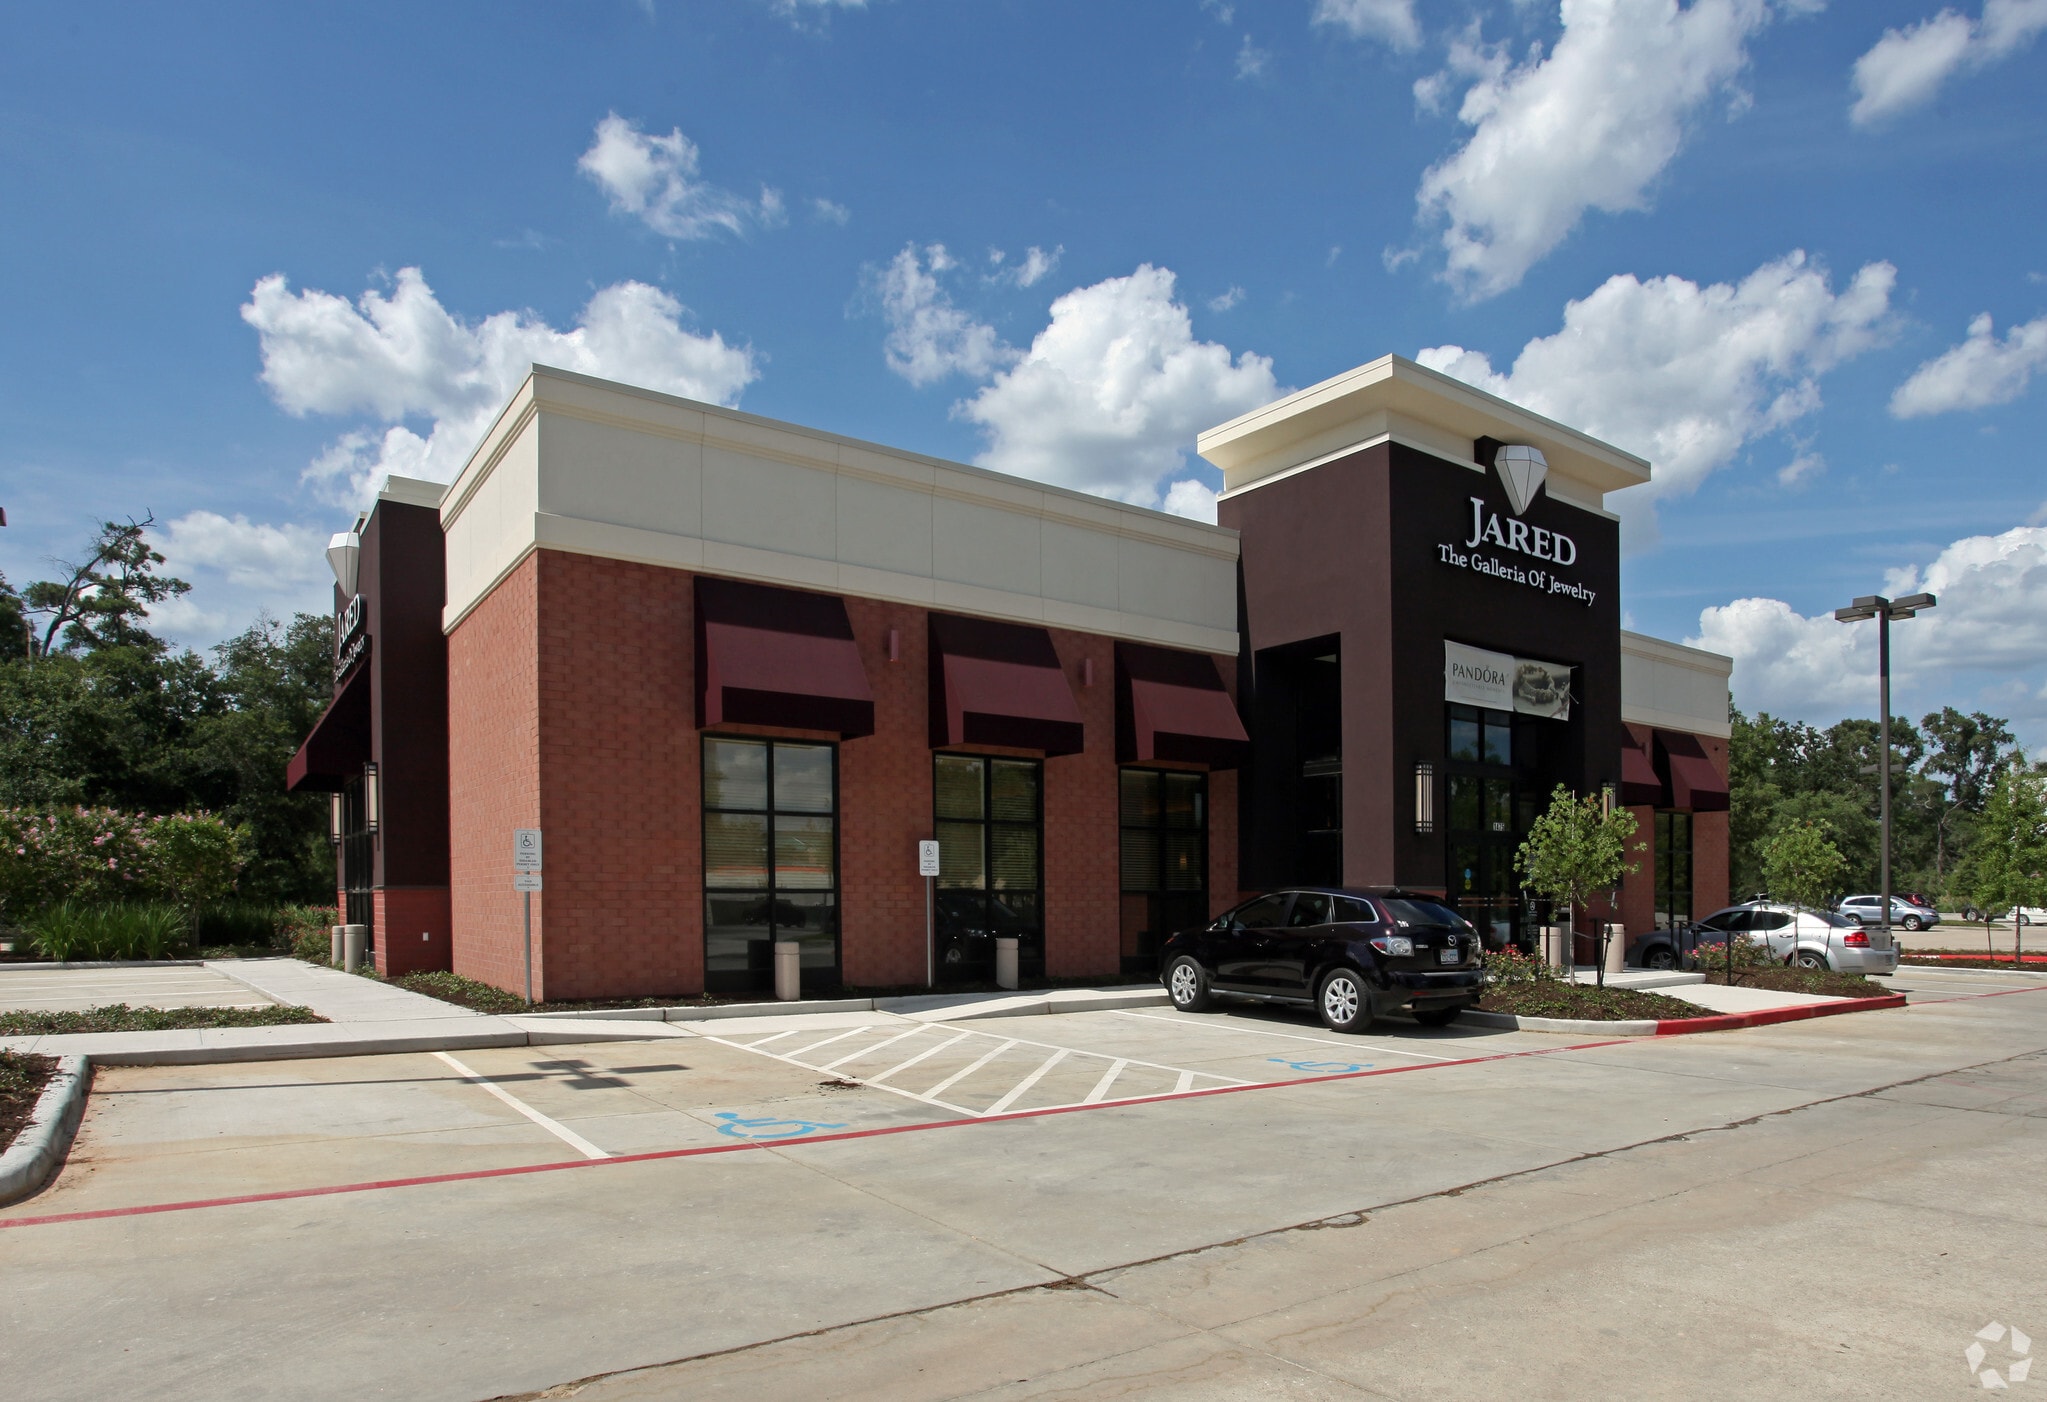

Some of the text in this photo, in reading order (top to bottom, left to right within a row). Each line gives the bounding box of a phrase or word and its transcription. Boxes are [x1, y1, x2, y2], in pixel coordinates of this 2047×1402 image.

[1466, 496, 1577, 566] JARED
[1438, 543, 1596, 607] The Galleria Of Jewelry
[337, 593, 361, 660] JARED
[1452, 662, 1505, 686] PANDORA
